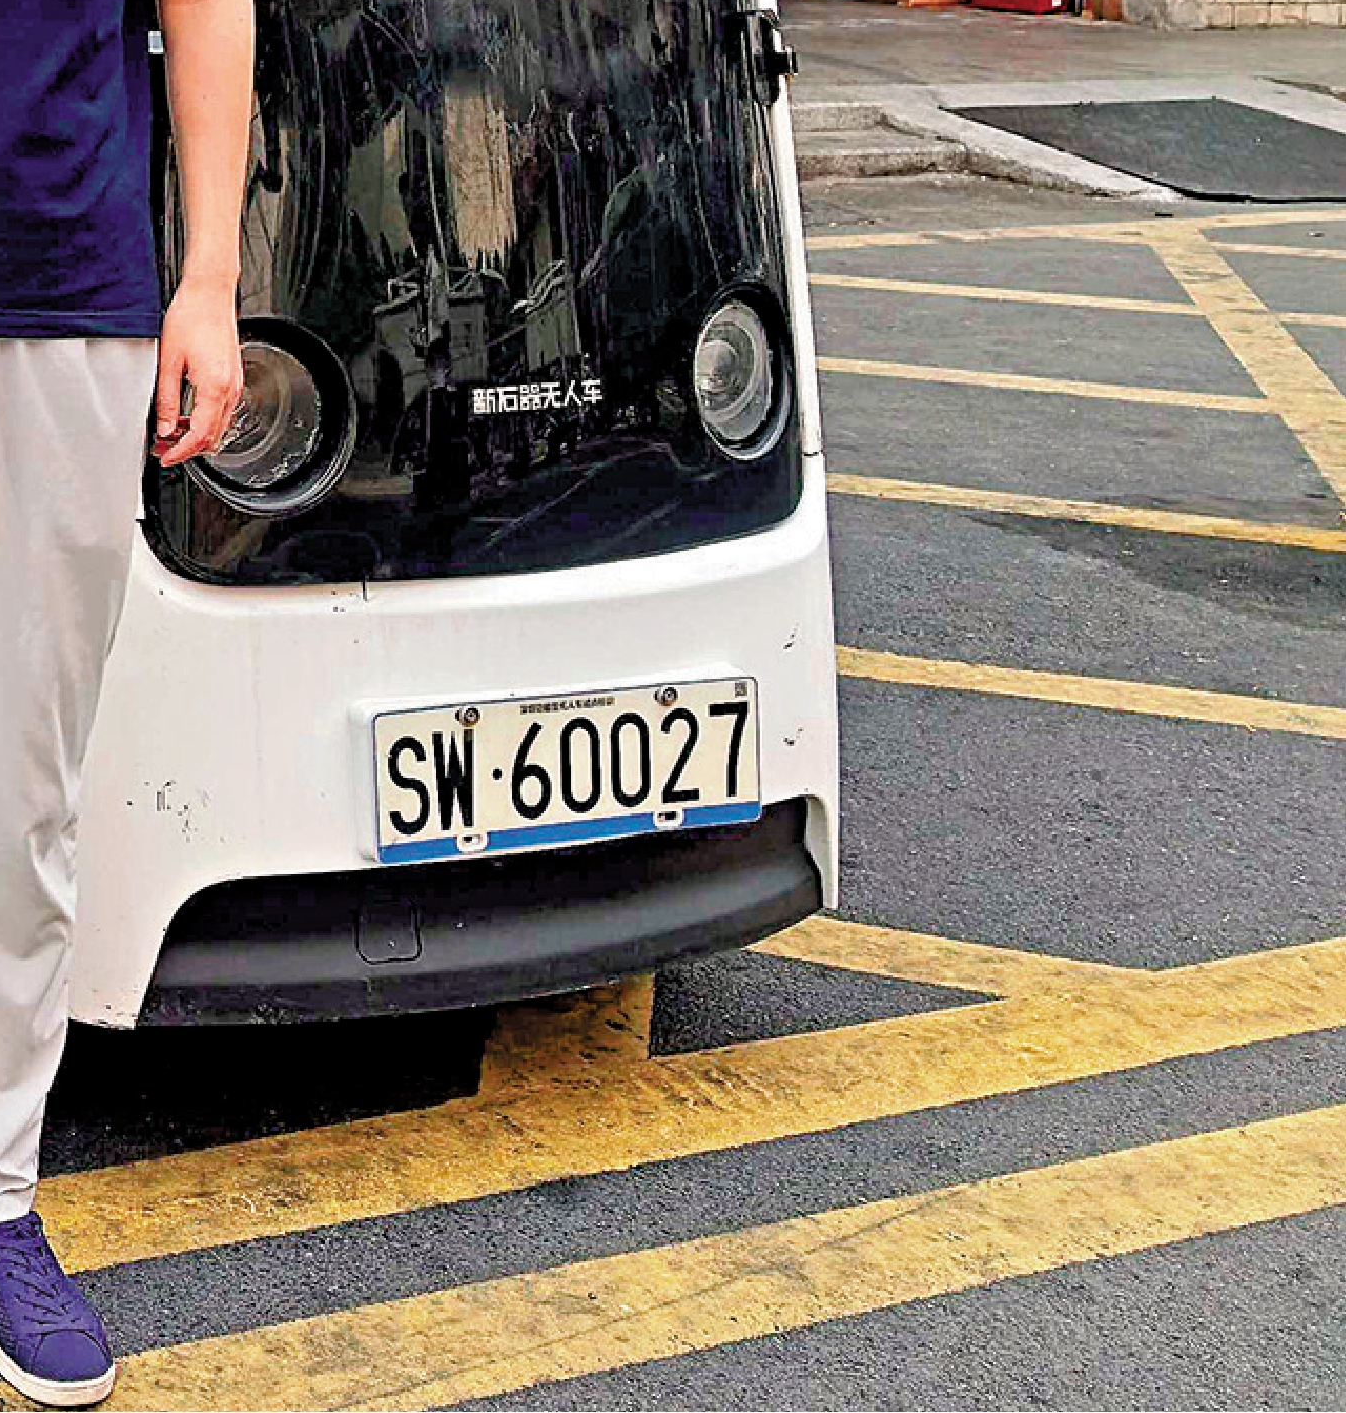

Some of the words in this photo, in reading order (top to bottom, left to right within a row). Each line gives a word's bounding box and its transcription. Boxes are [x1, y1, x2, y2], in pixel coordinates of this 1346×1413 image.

[472, 379, 603, 414] 新石器无人车
